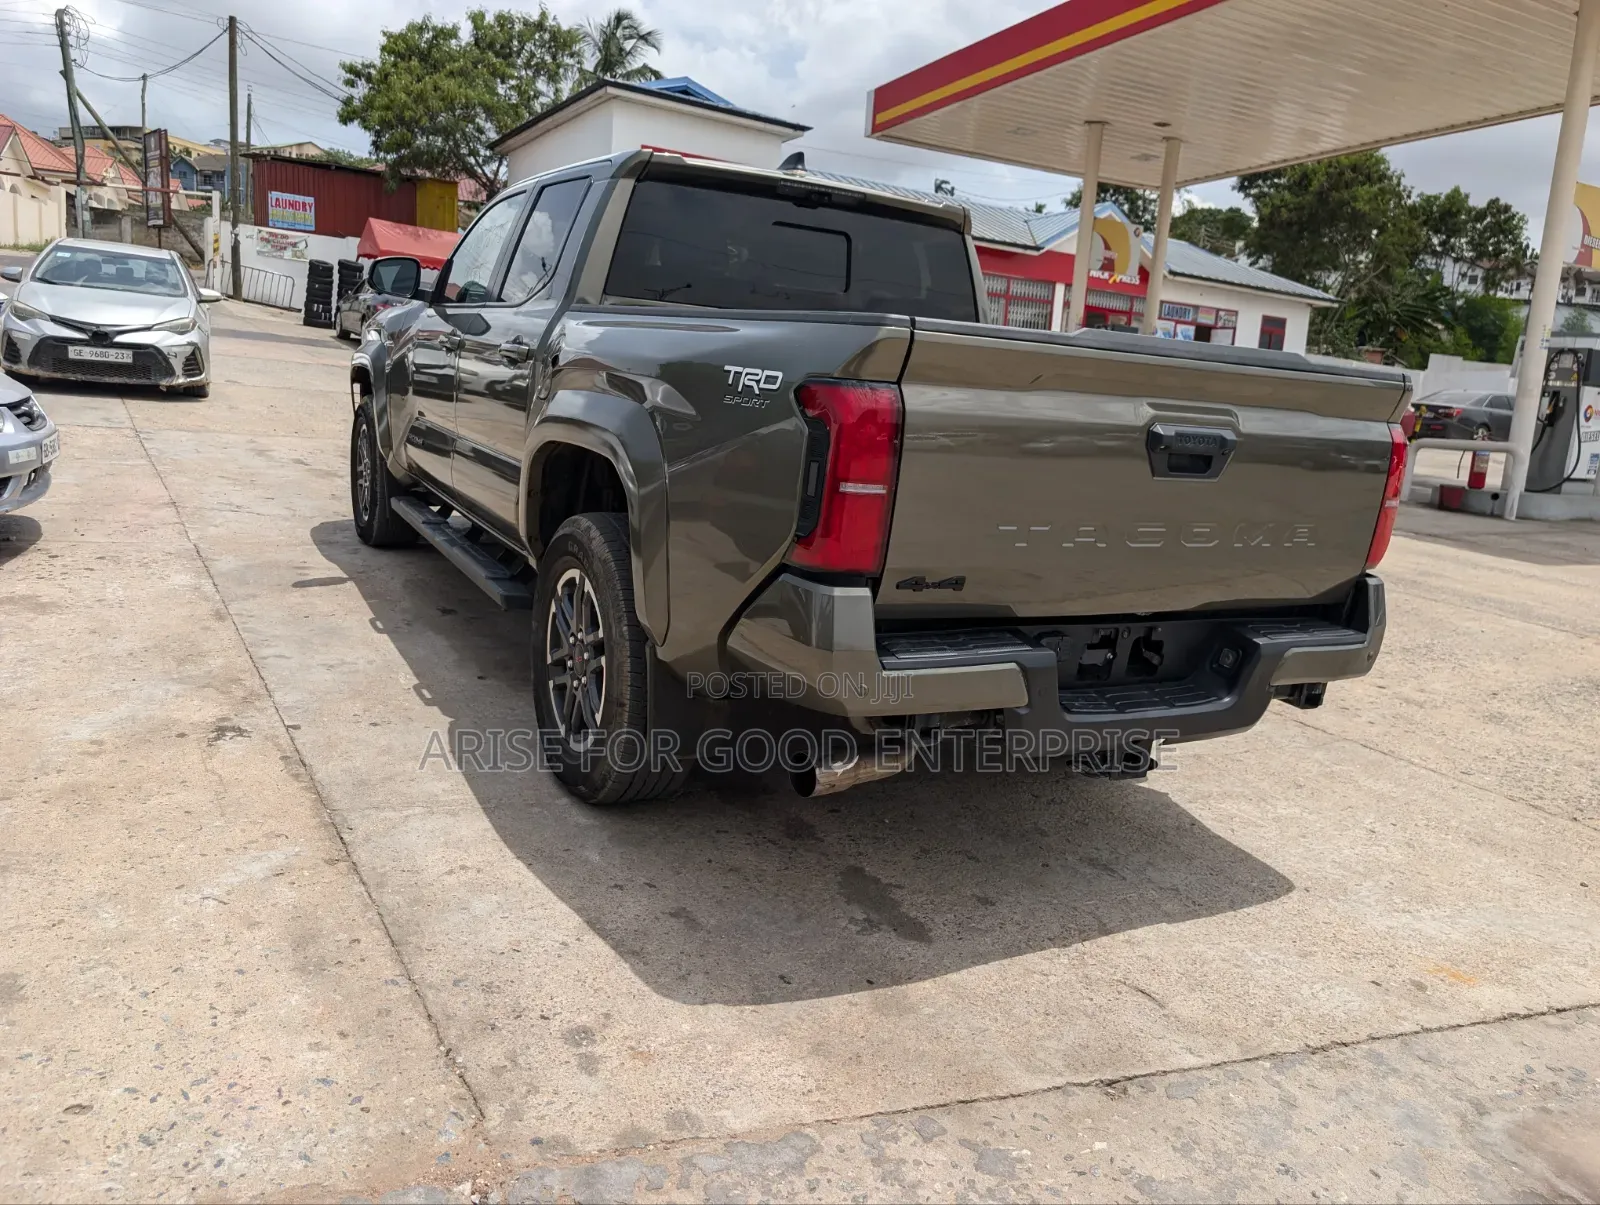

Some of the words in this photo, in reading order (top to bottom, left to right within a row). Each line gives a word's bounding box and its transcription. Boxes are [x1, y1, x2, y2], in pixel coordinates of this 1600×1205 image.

[270, 196, 314, 213] LAUNDRY
[1163, 303, 1192, 319] LAUNDRY
[73, 349, 84, 357] GE
[723, 364, 784, 395] TRD
[723, 395, 771, 409] SPORT
[1178, 435, 1218, 449] TOYOTA
[998, 523, 1316, 548] TACOMA
